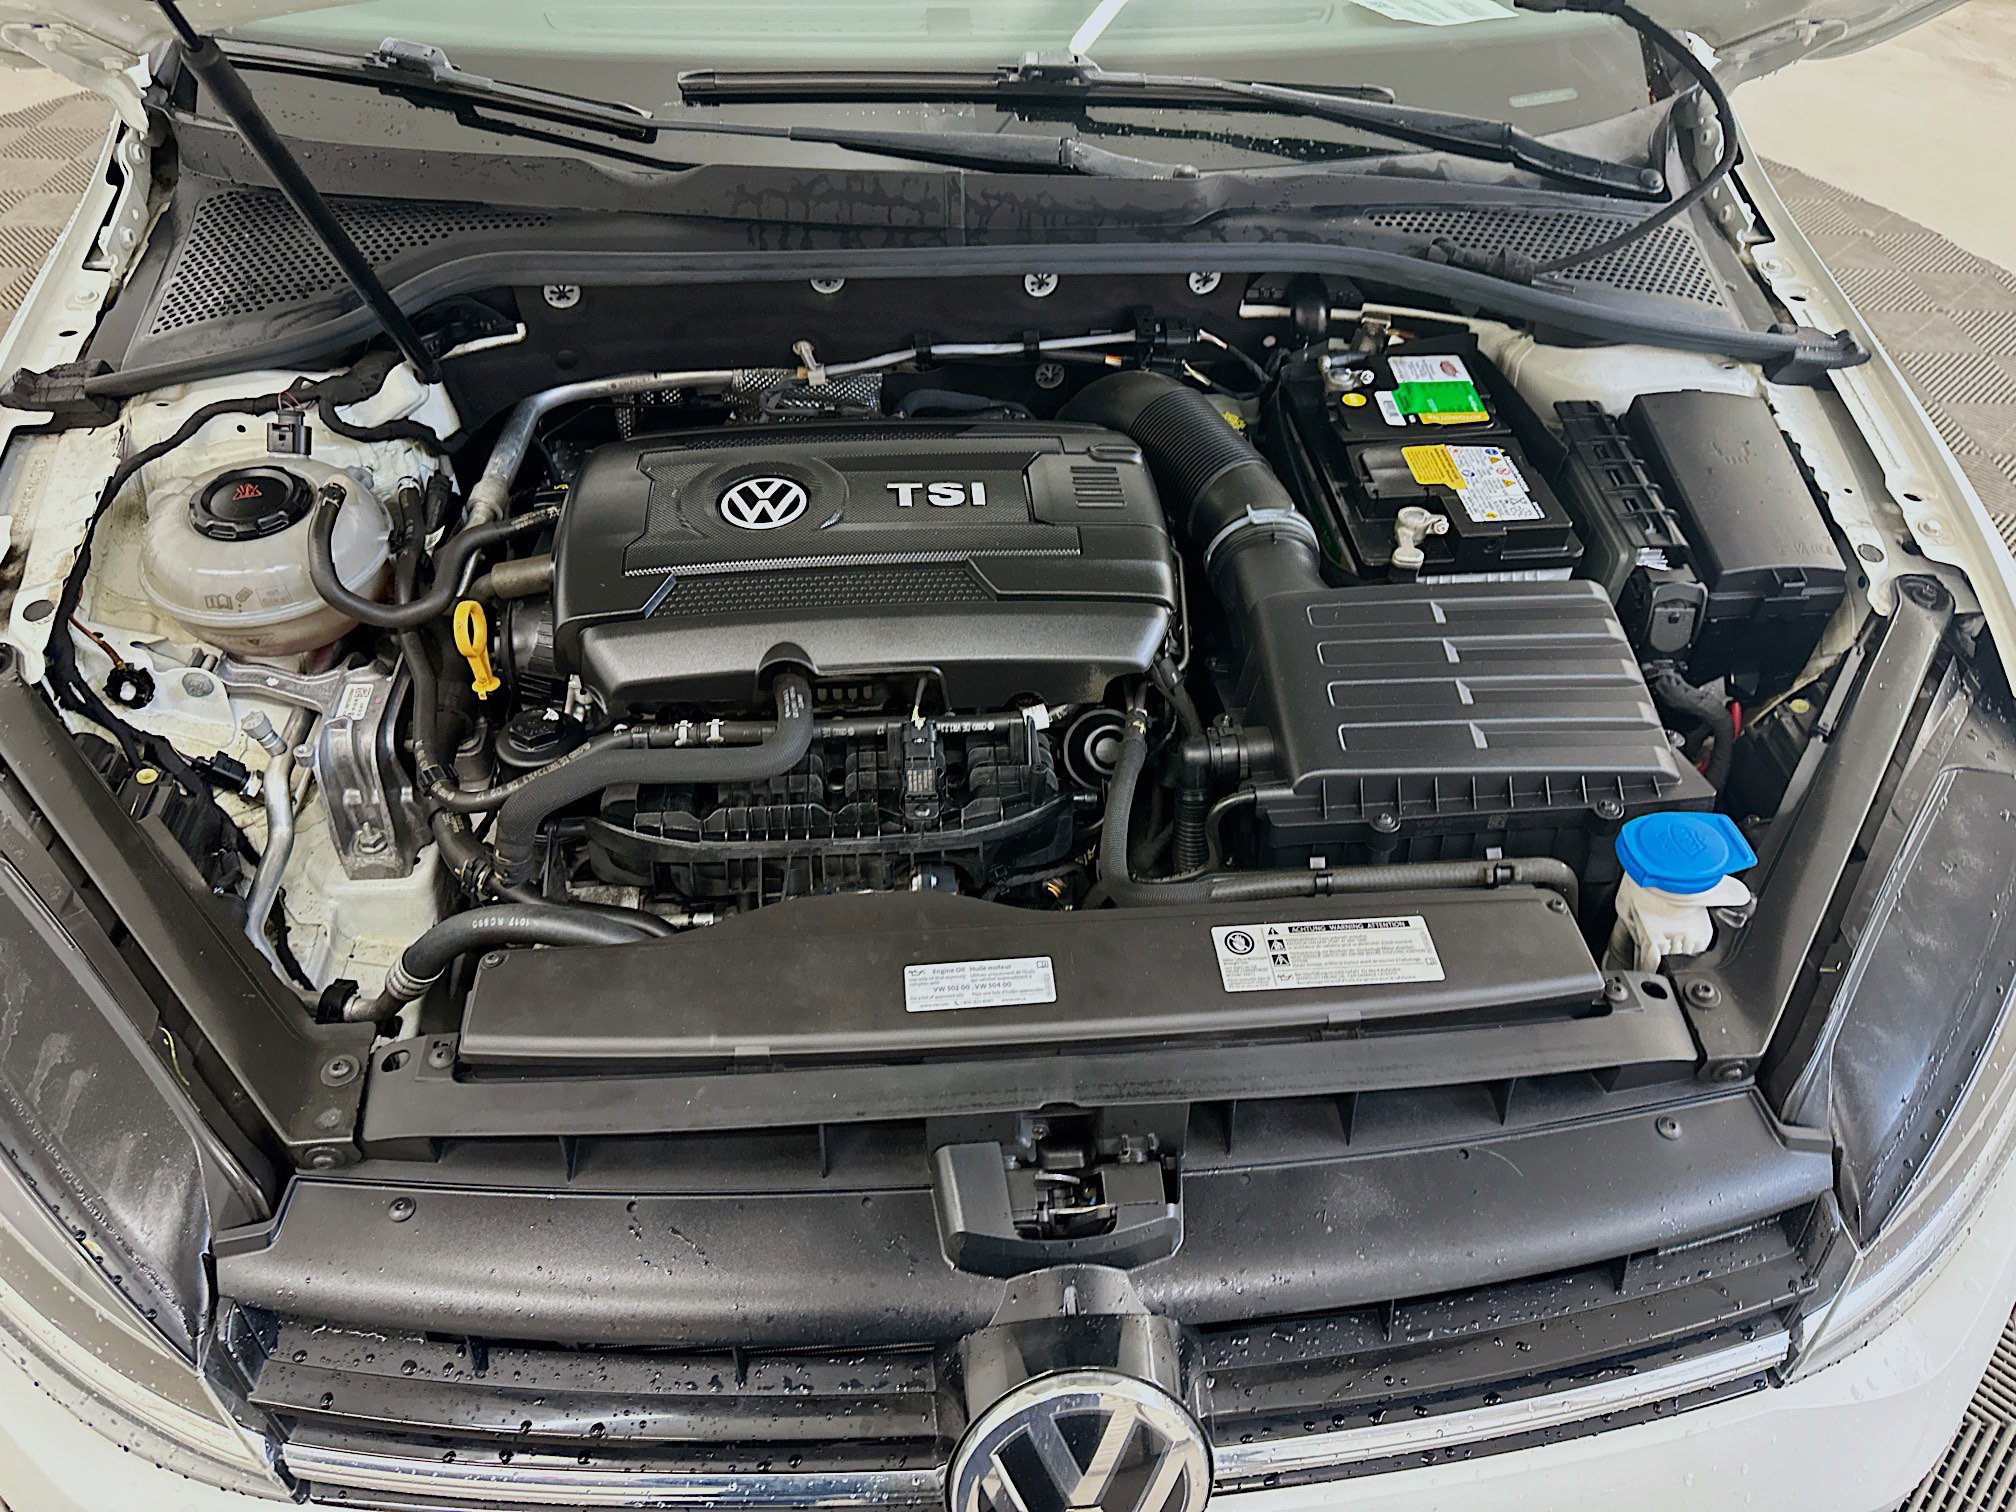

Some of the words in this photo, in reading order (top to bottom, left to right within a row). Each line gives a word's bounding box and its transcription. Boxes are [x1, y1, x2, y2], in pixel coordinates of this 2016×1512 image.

[721, 478, 807, 529] VW
[886, 482, 987, 507] TSI
[1329, 923, 1364, 931] WARNING
[1367, 920, 1406, 929] ATTENTION
